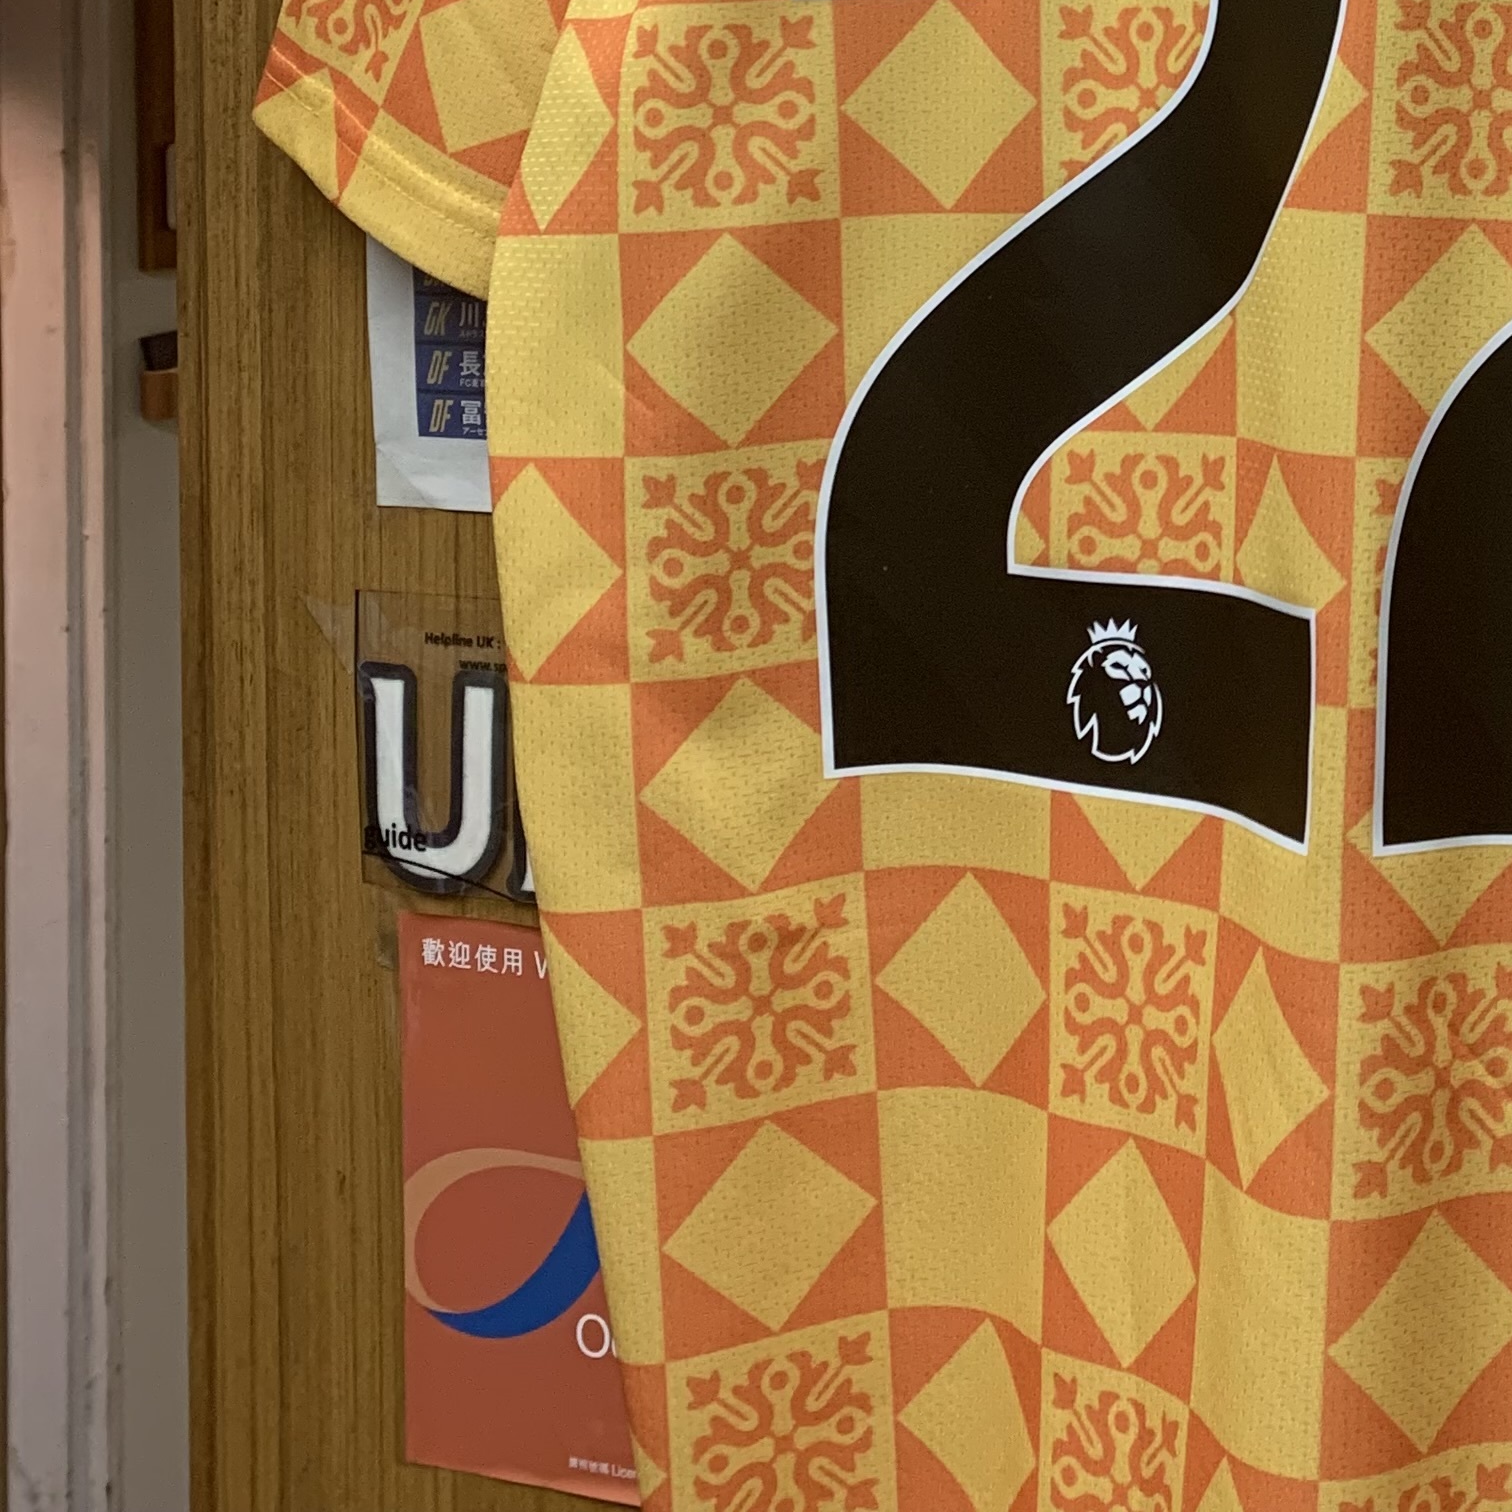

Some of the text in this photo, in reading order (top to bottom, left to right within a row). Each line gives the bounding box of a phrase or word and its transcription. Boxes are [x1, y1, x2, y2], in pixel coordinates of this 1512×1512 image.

[424, 301, 485, 337] GK 川
[427, 350, 485, 384] DF 長
[429, 399, 487, 433] DF 富
[462, 426, 487, 437] アーセ
[424, 632, 473, 648] Helpline
[476, 635, 494, 648] UK
[364, 822, 427, 852] guide
[421, 937, 522, 976] 歡迎使用
[576, 1312, 617, 1359] O
